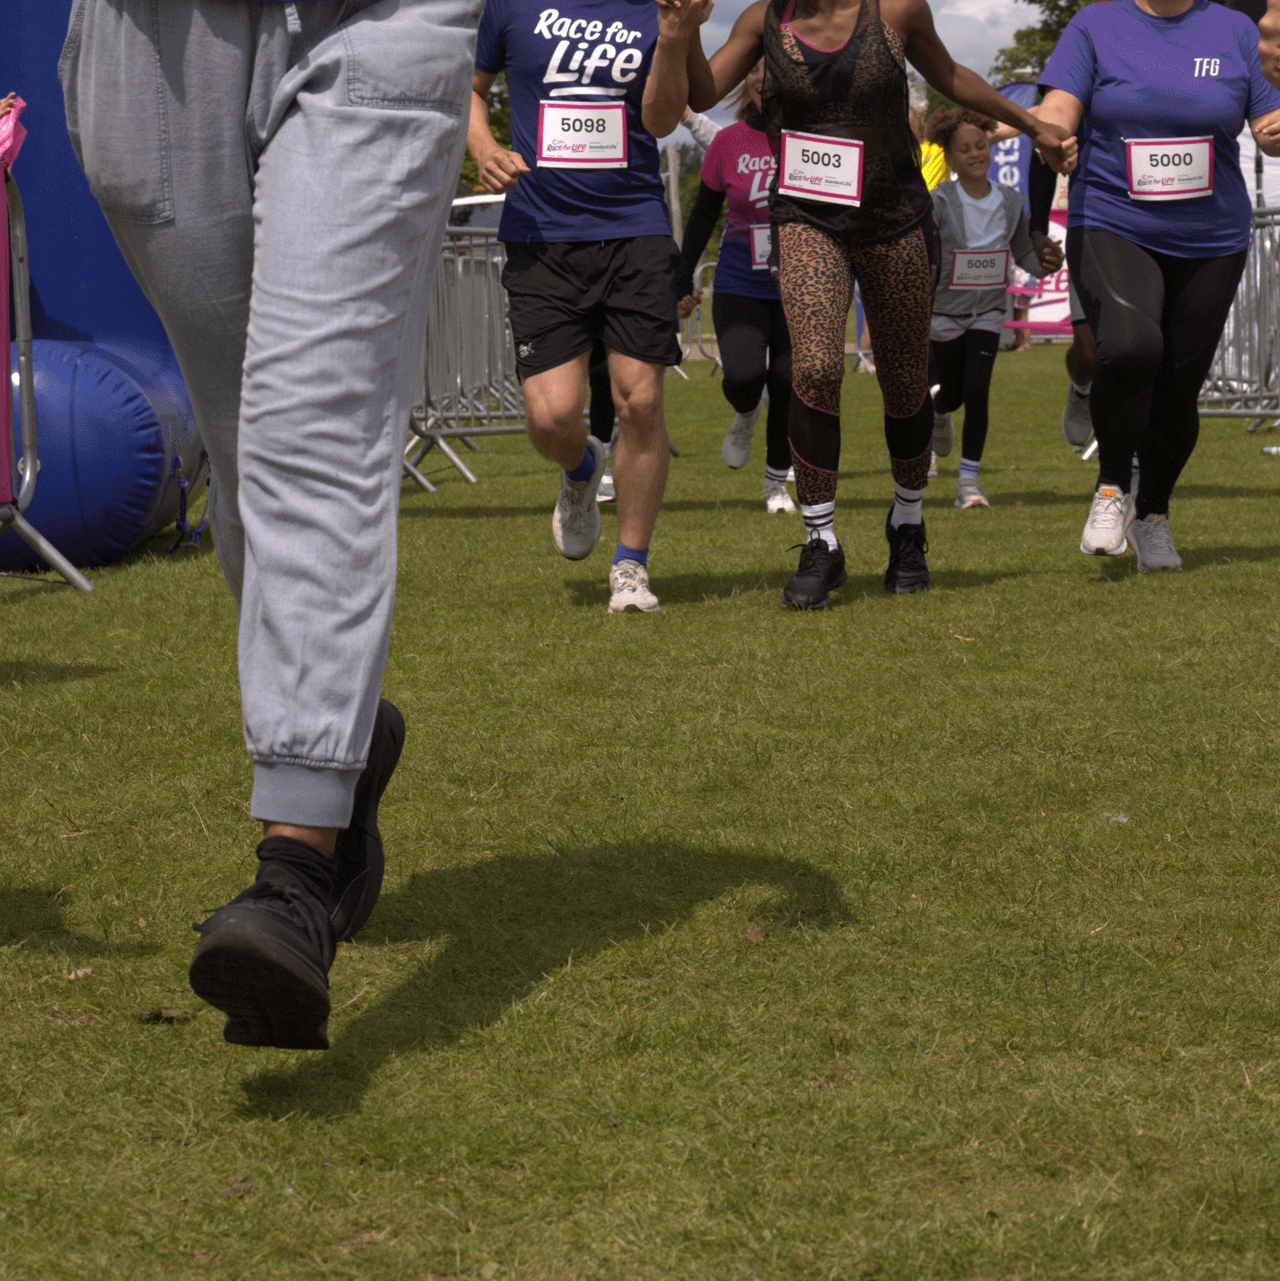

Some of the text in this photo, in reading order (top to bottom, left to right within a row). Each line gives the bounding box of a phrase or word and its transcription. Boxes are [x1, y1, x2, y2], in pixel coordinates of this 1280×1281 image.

[533, 8, 642, 45] Race for
[542, 40, 643, 85] Life
[1193, 57, 1220, 78] TFG
[561, 117, 606, 133] 5098
[801, 148, 842, 169] 5003
[995, 136, 1020, 191] ets
[1149, 152, 1193, 168] 5000
[967, 258, 996, 269] 5005
